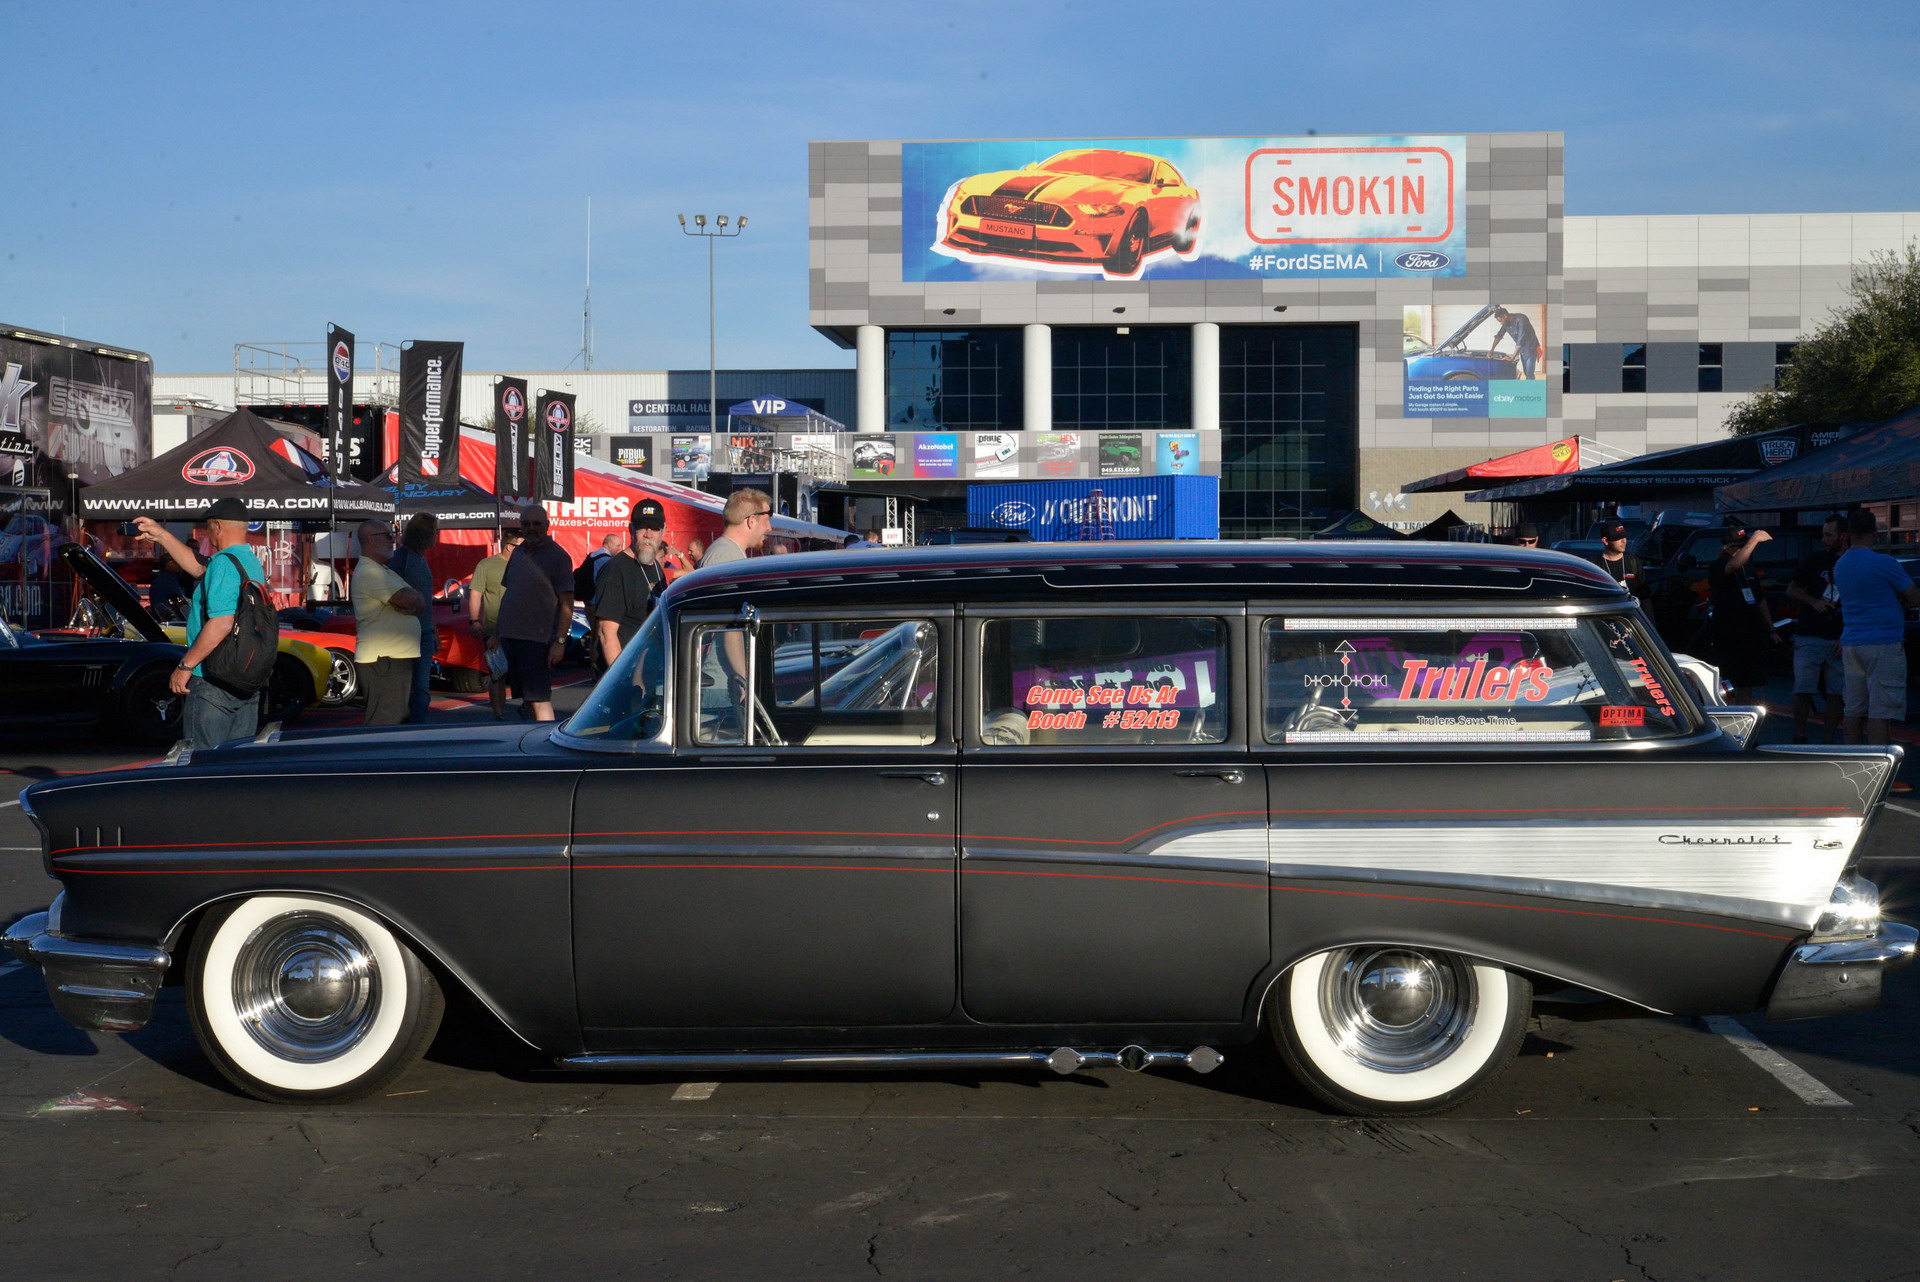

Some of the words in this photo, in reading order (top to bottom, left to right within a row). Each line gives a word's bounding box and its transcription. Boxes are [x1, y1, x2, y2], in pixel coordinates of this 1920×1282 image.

[1272, 175, 1425, 216] SMOK1N
[985, 224, 1026, 236] MUSTANG
[1249, 253, 1369, 271] #FordSEMA
[1404, 253, 1440, 269] Ford
[1408, 385, 1432, 393] Finding
[1444, 385, 1462, 393] Right
[1493, 394, 1515, 403] ebay
[421, 359, 443, 459] Superformance
[645, 403, 688, 414] CENTRAL
[752, 400, 787, 414] VIP
[632, 425, 677, 433] RESTORATION
[1764, 441, 1795, 449] TRUCK
[1765, 449, 1792, 457] HERO
[187, 468, 247, 480] SHELBY
[84, 498, 329, 510] WWW.HILLBAUSA.COM
[542, 497, 630, 518] THERS
[642, 507, 656, 515] CAT
[1398, 659, 1554, 701] Trulers
[1630, 656, 1676, 717] Trulers
[1026, 685, 1084, 705] Come
[1086, 685, 1126, 705] See
[1128, 685, 1152, 704] Us
[1154, 684, 1179, 704] At
[1026, 710, 1088, 729] Booth
[1102, 710, 1181, 729] #52413
[1603, 709, 1642, 718] OPTIMA
[1416, 715, 1456, 726] Trulers
[1457, 715, 1486, 726] Save
[1487, 715, 1519, 726] Time.
[1658, 834, 1792, 846] Chevrolet
